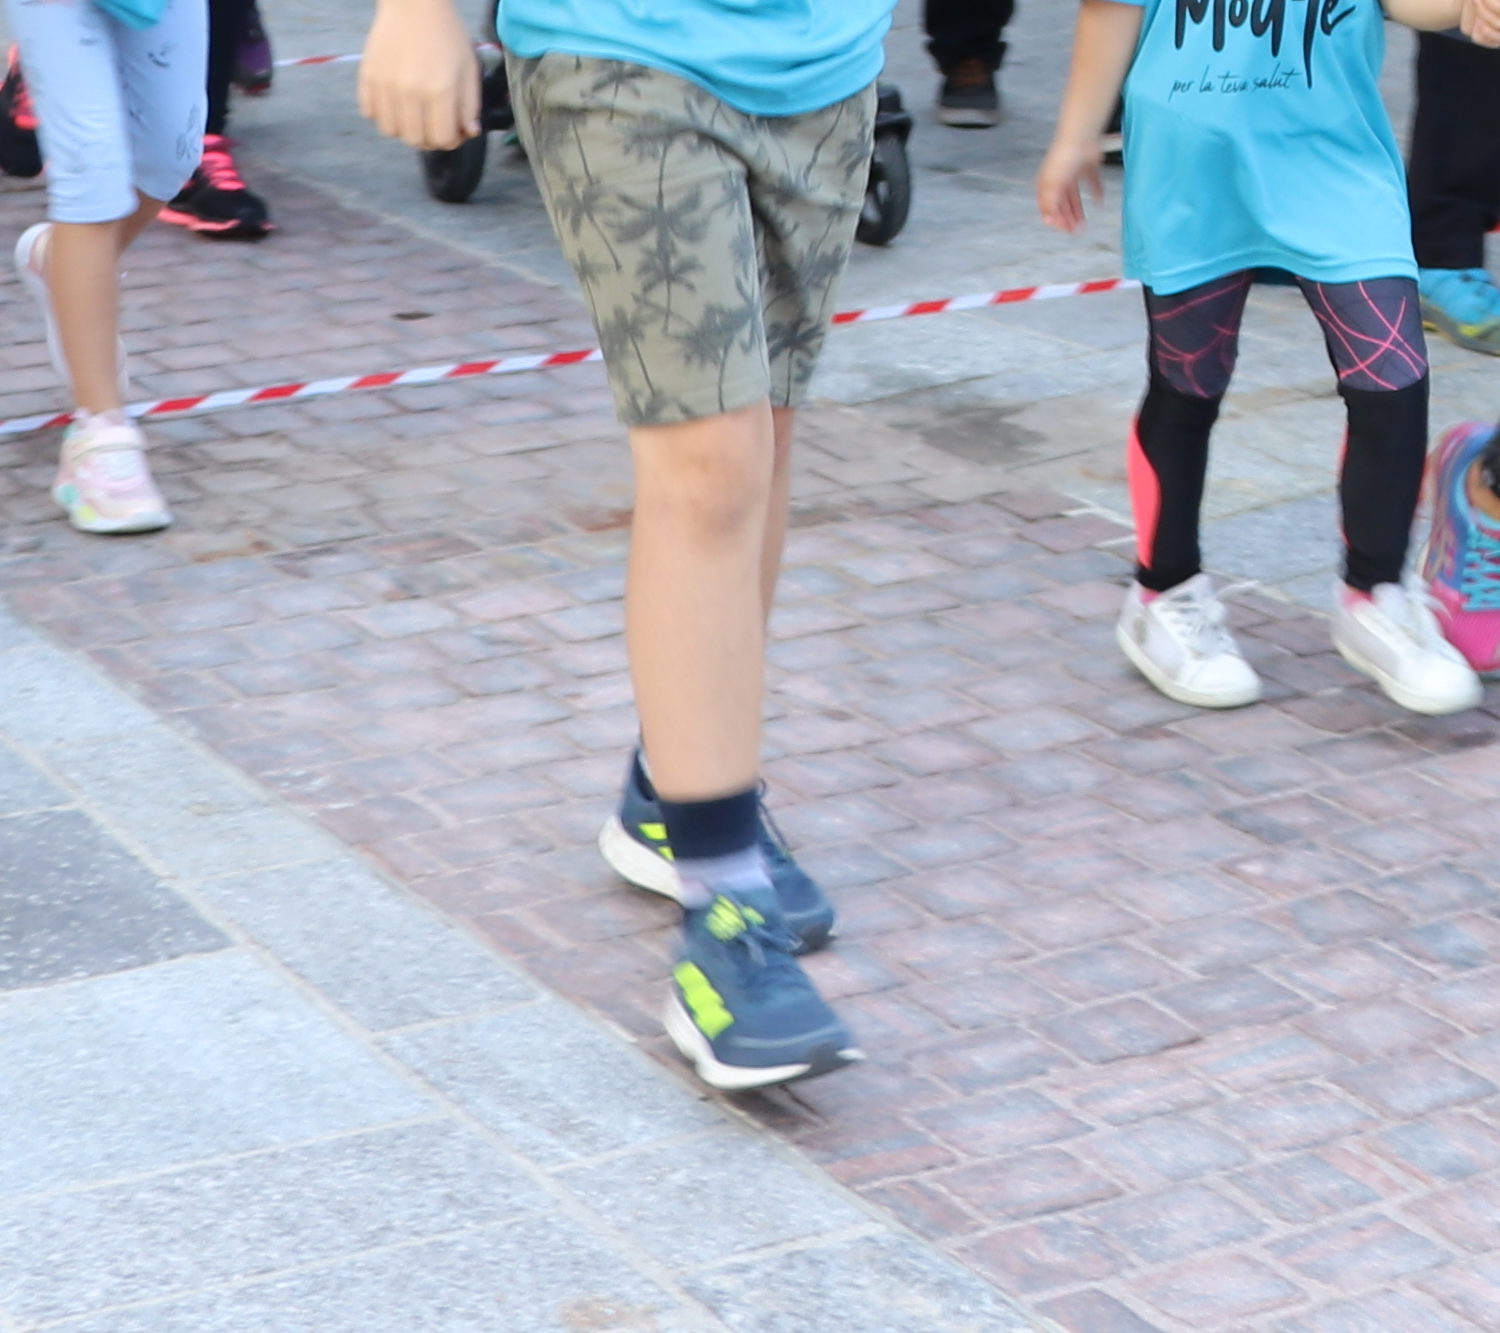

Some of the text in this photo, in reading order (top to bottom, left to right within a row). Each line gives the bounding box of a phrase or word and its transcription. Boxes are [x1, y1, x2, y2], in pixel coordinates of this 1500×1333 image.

[1168, 61, 1301, 103] per la teva salut
